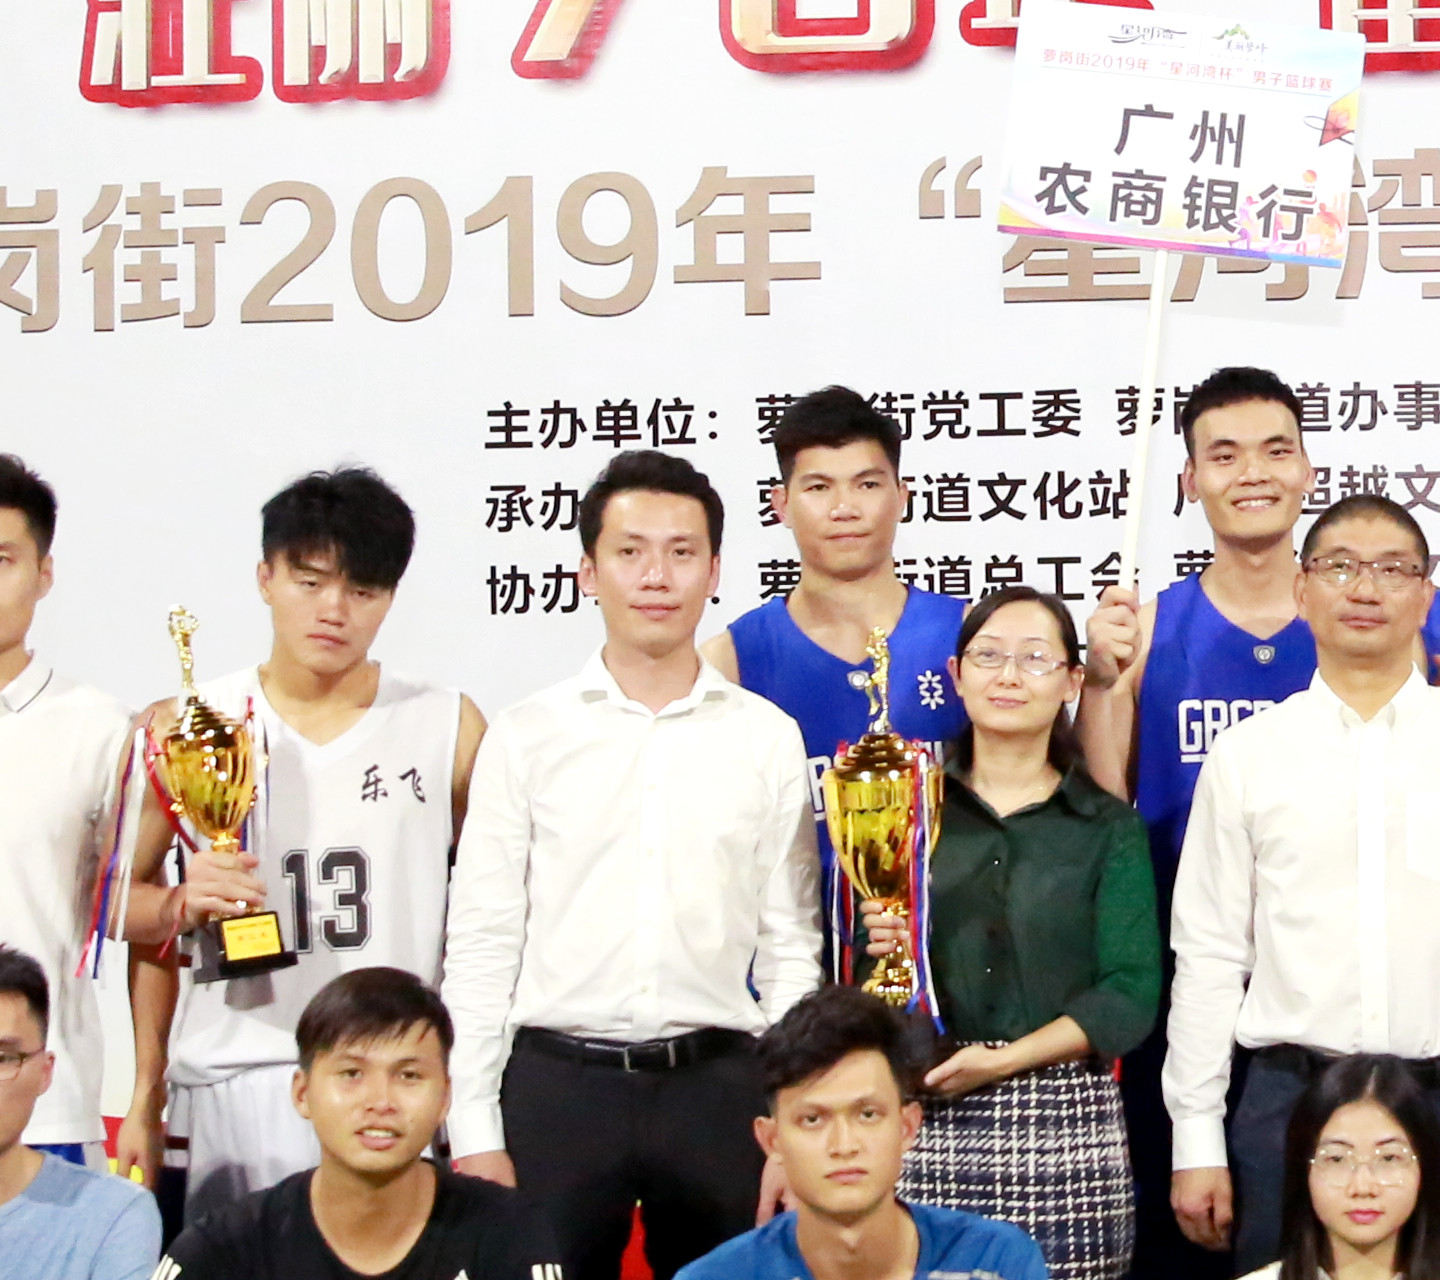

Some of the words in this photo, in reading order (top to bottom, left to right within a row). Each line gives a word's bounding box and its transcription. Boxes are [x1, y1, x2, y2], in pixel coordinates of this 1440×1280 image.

[1113, 104, 1246, 168] 广州
[1034, 162, 1315, 241] 农商银行
[281, 846, 372, 955] 13
